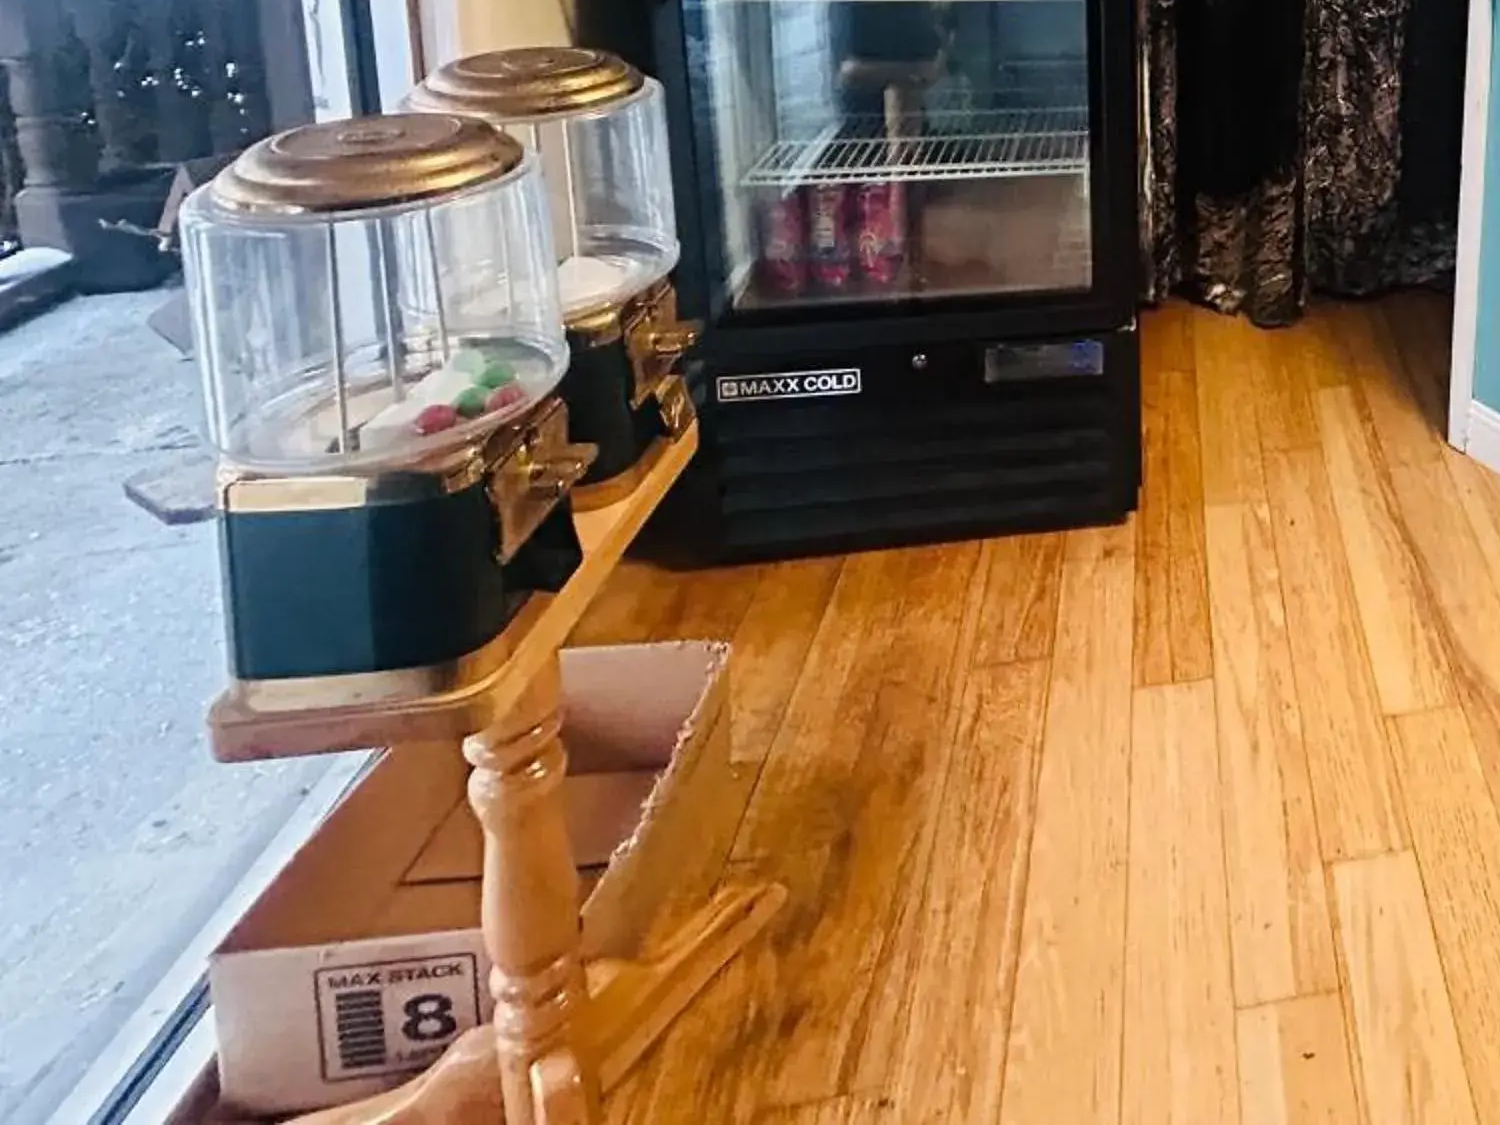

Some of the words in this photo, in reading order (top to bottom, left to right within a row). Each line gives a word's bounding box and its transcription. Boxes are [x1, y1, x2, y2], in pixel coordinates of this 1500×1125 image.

[740, 377, 800, 396] MAXX
[803, 374, 857, 391] COLD
[328, 971, 382, 988] MAX
[387, 962, 465, 984] STACK
[401, 993, 457, 1041] 8
